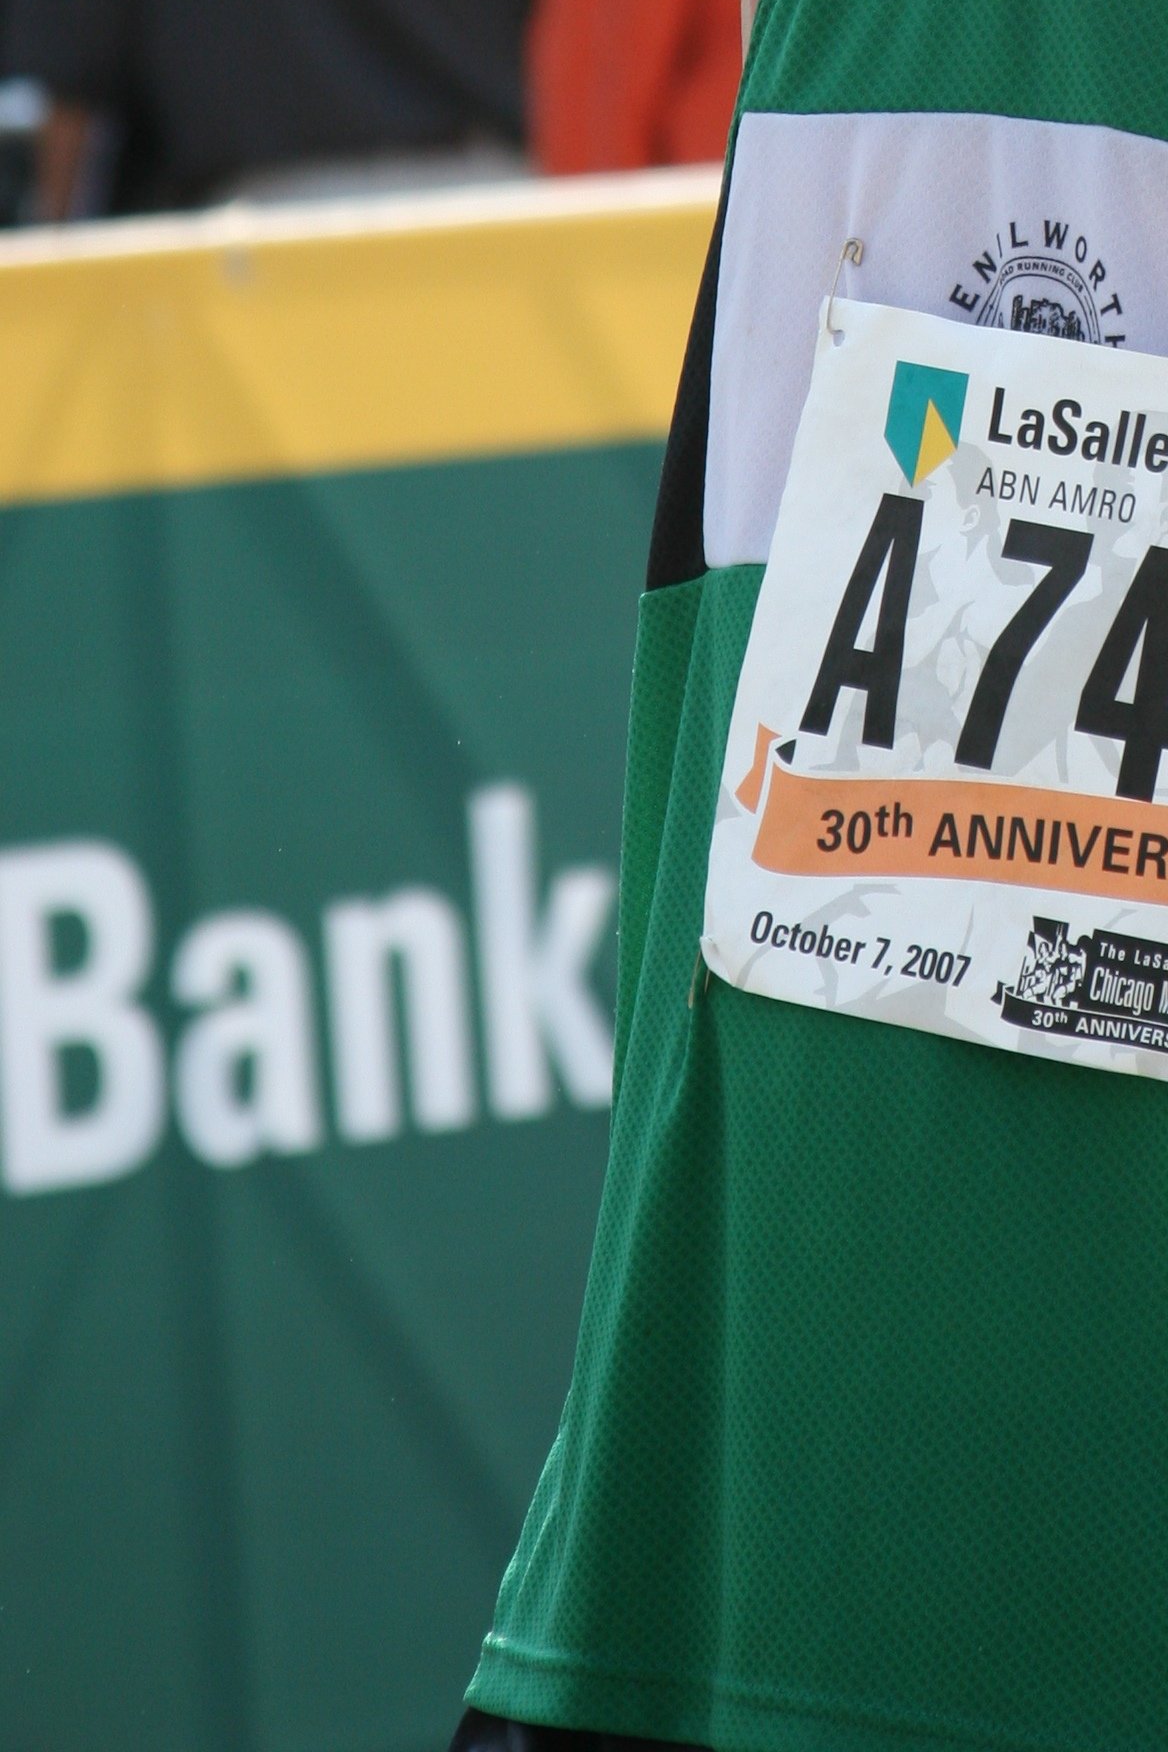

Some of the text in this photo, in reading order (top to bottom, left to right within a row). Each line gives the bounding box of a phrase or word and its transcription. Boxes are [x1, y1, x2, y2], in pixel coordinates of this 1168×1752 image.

[1016, 262, 1065, 277] RUNNING
[1066, 273, 1084, 293] CLUB
[976, 467, 1137, 524] ABN AMRO
[799, 493, 925, 750] A
[816, 802, 914, 854] 30th
[750, 910, 972, 988] October 7, 2007
[1099, 942, 1126, 962] The
[0, 781, 617, 1196] Bank
[1089, 966, 1155, 1016] Chicago
[1032, 1010, 1068, 1029] 30th
